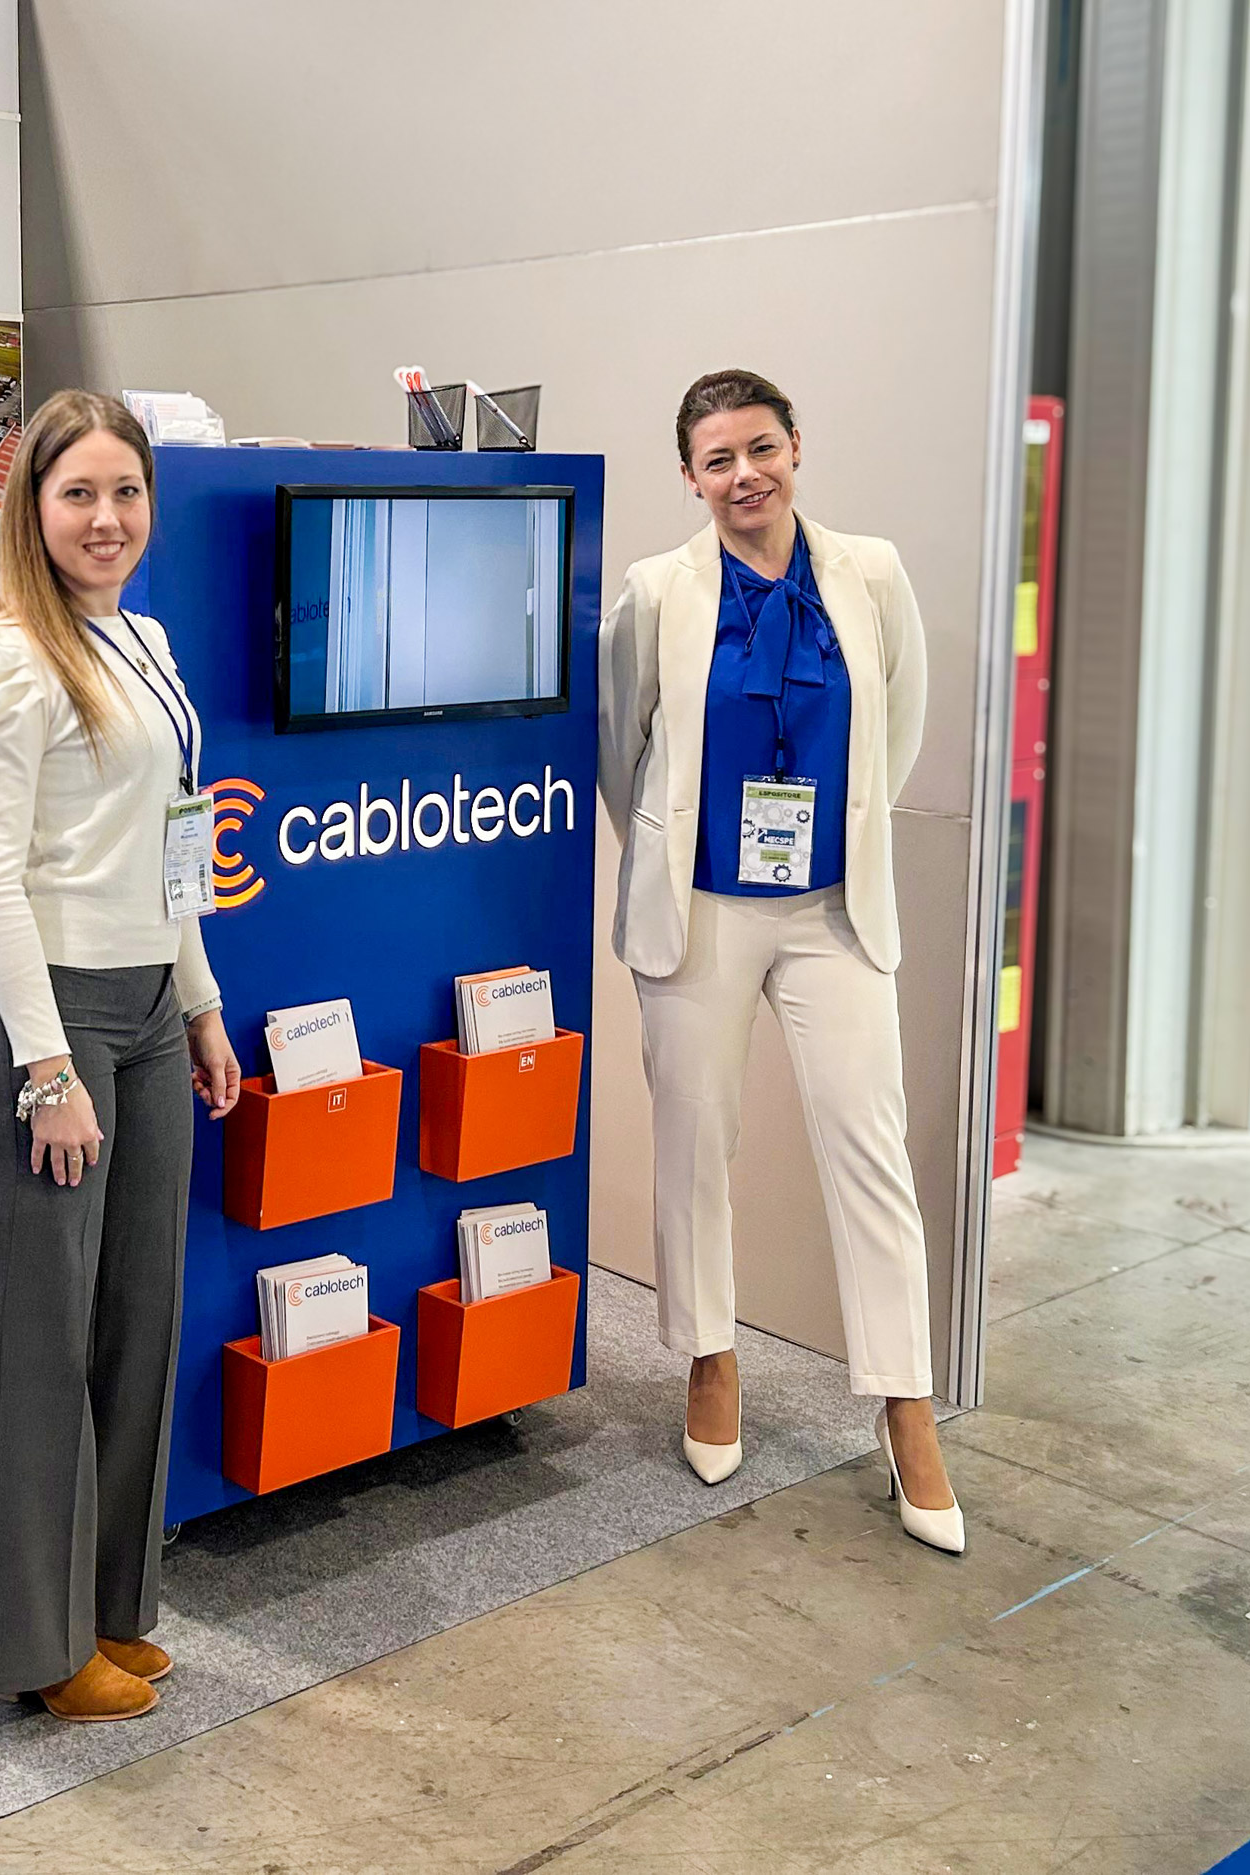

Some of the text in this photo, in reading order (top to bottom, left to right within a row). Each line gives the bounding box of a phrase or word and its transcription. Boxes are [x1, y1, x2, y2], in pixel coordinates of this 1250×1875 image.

[279, 765, 574, 865] cablotech
[491, 977, 547, 1000] cablotech
[287, 1011, 341, 1041] cablotech
[520, 1055, 534, 1067] EN
[332, 1094, 343, 1106] IT
[494, 1217, 544, 1238] cablotech
[304, 1274, 364, 1298] cablotech
